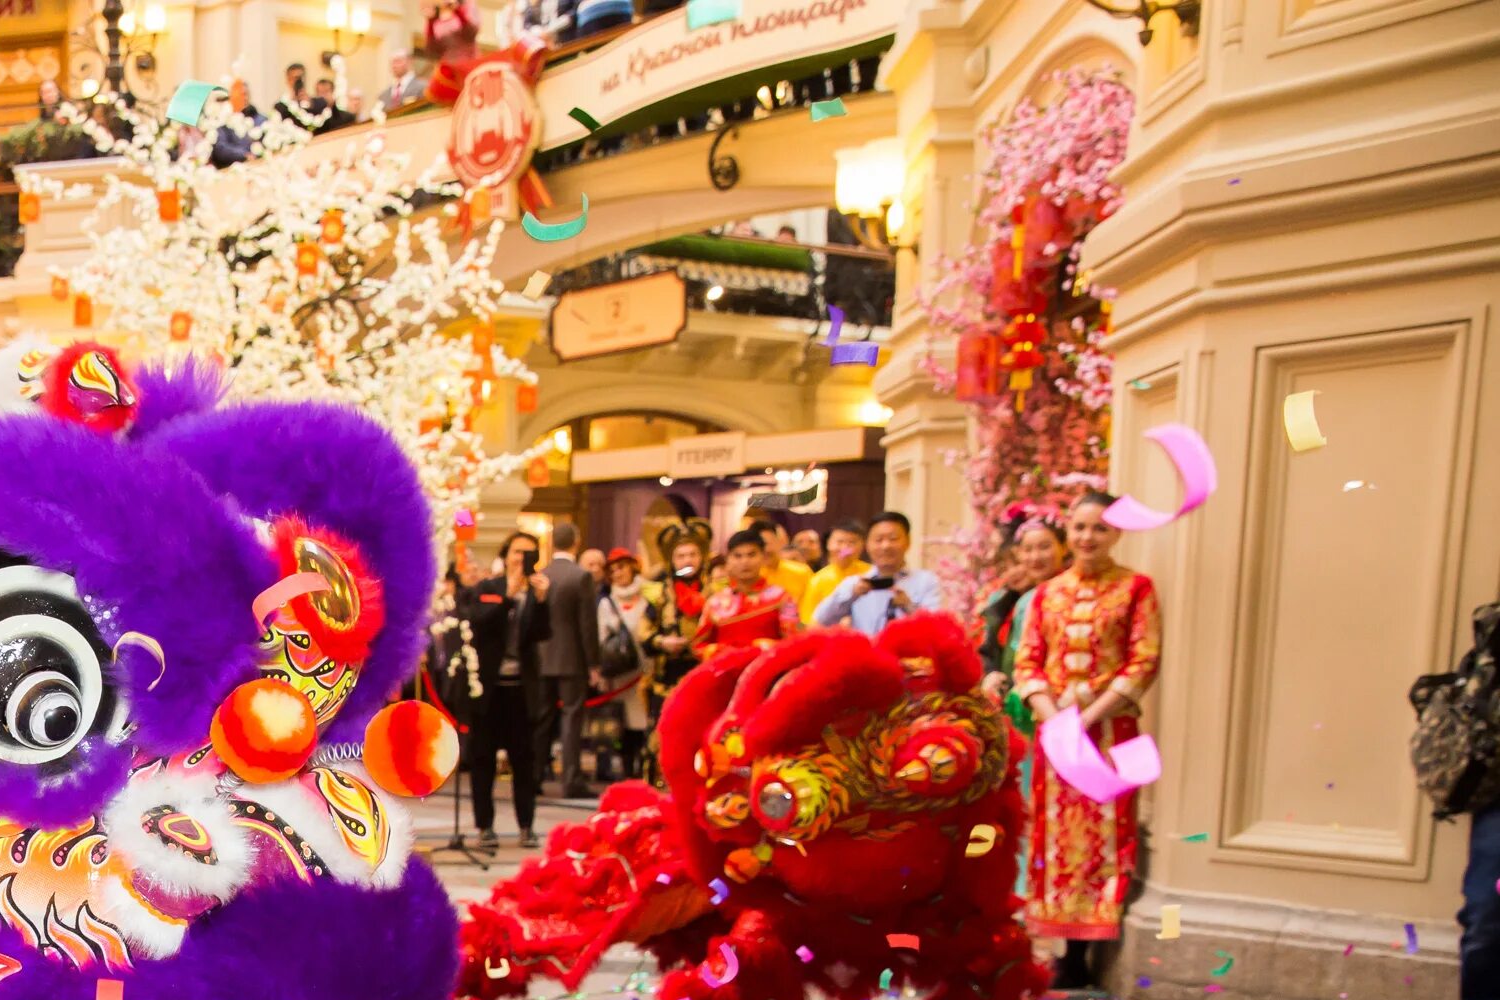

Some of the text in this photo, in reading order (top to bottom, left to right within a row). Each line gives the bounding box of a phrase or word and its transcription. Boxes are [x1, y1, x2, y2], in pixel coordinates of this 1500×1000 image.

[601, 0, 867, 93] на Красной площади
